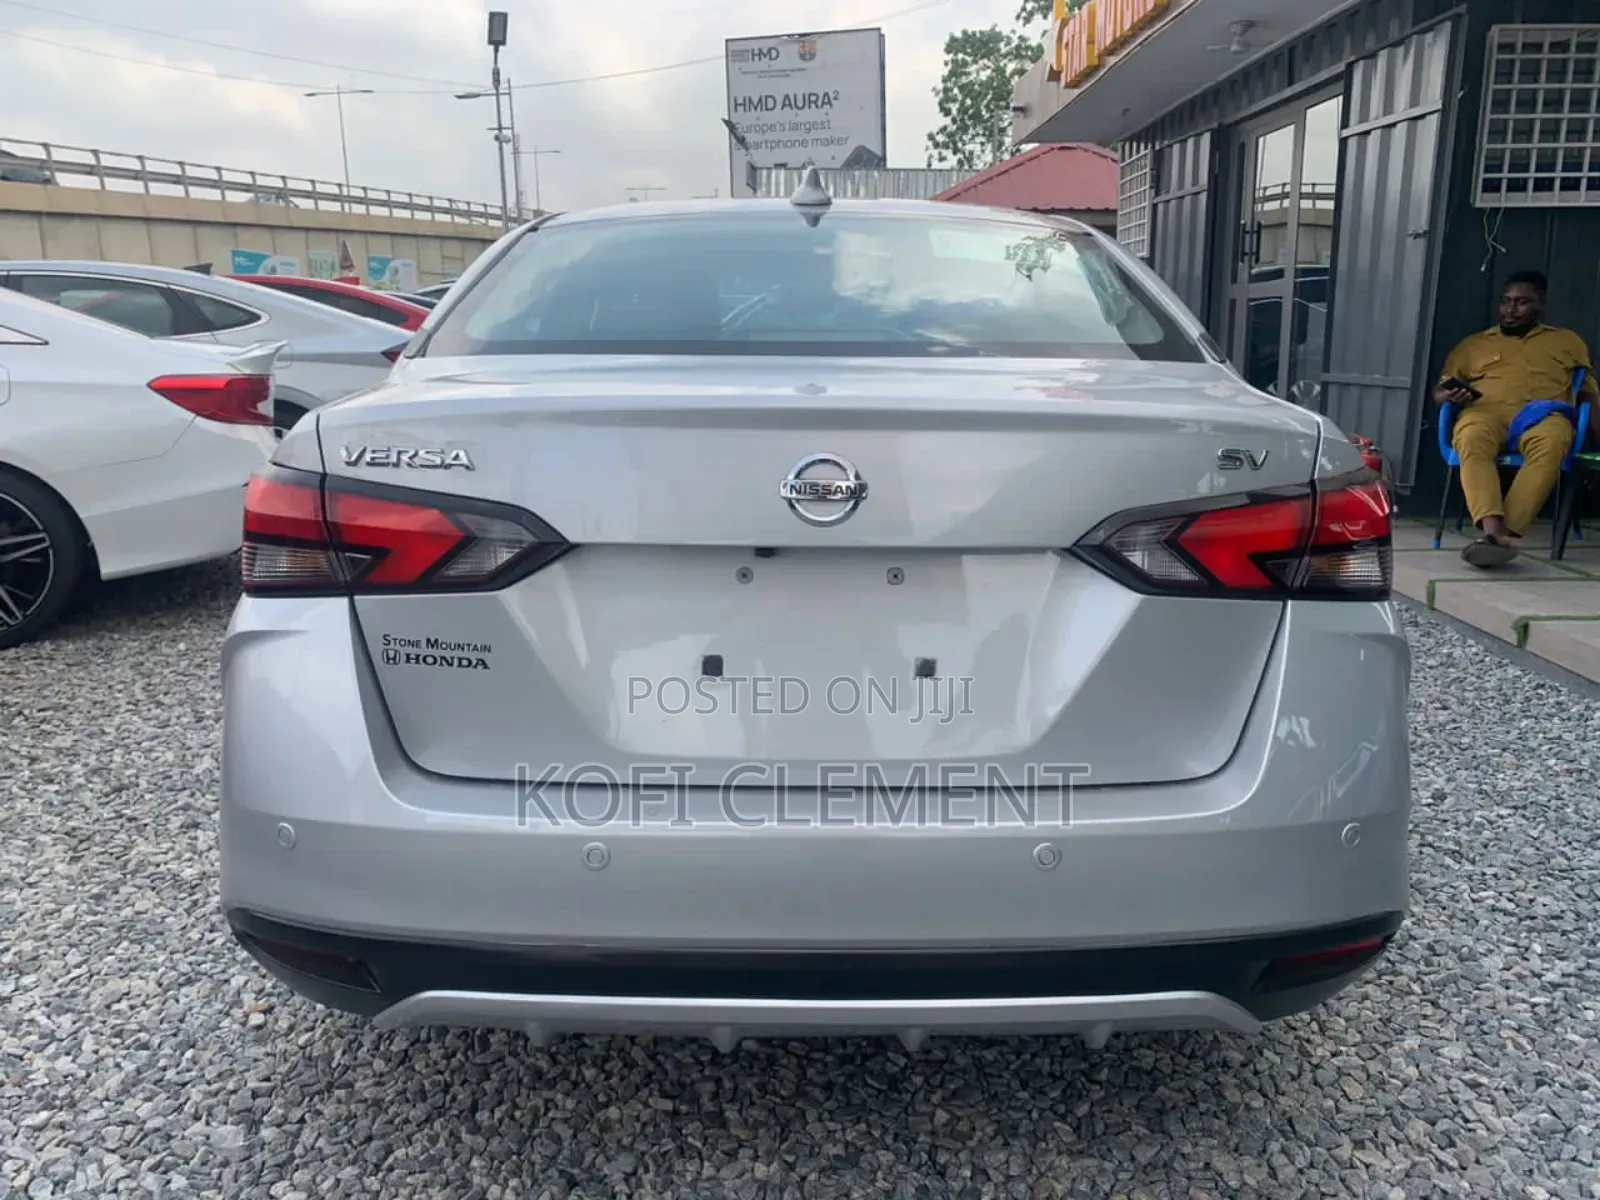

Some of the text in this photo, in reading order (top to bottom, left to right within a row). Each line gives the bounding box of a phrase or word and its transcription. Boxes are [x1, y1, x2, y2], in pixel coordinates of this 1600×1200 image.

[751, 47, 779, 62] HMD
[733, 94, 777, 113] HMD
[788, 119, 831, 134] largest
[811, 135, 850, 147] maker
[339, 444, 476, 471] VERSA
[1217, 448, 1271, 471] SV
[789, 483, 858, 496] NISSAN
[404, 652, 491, 670] HONDA
